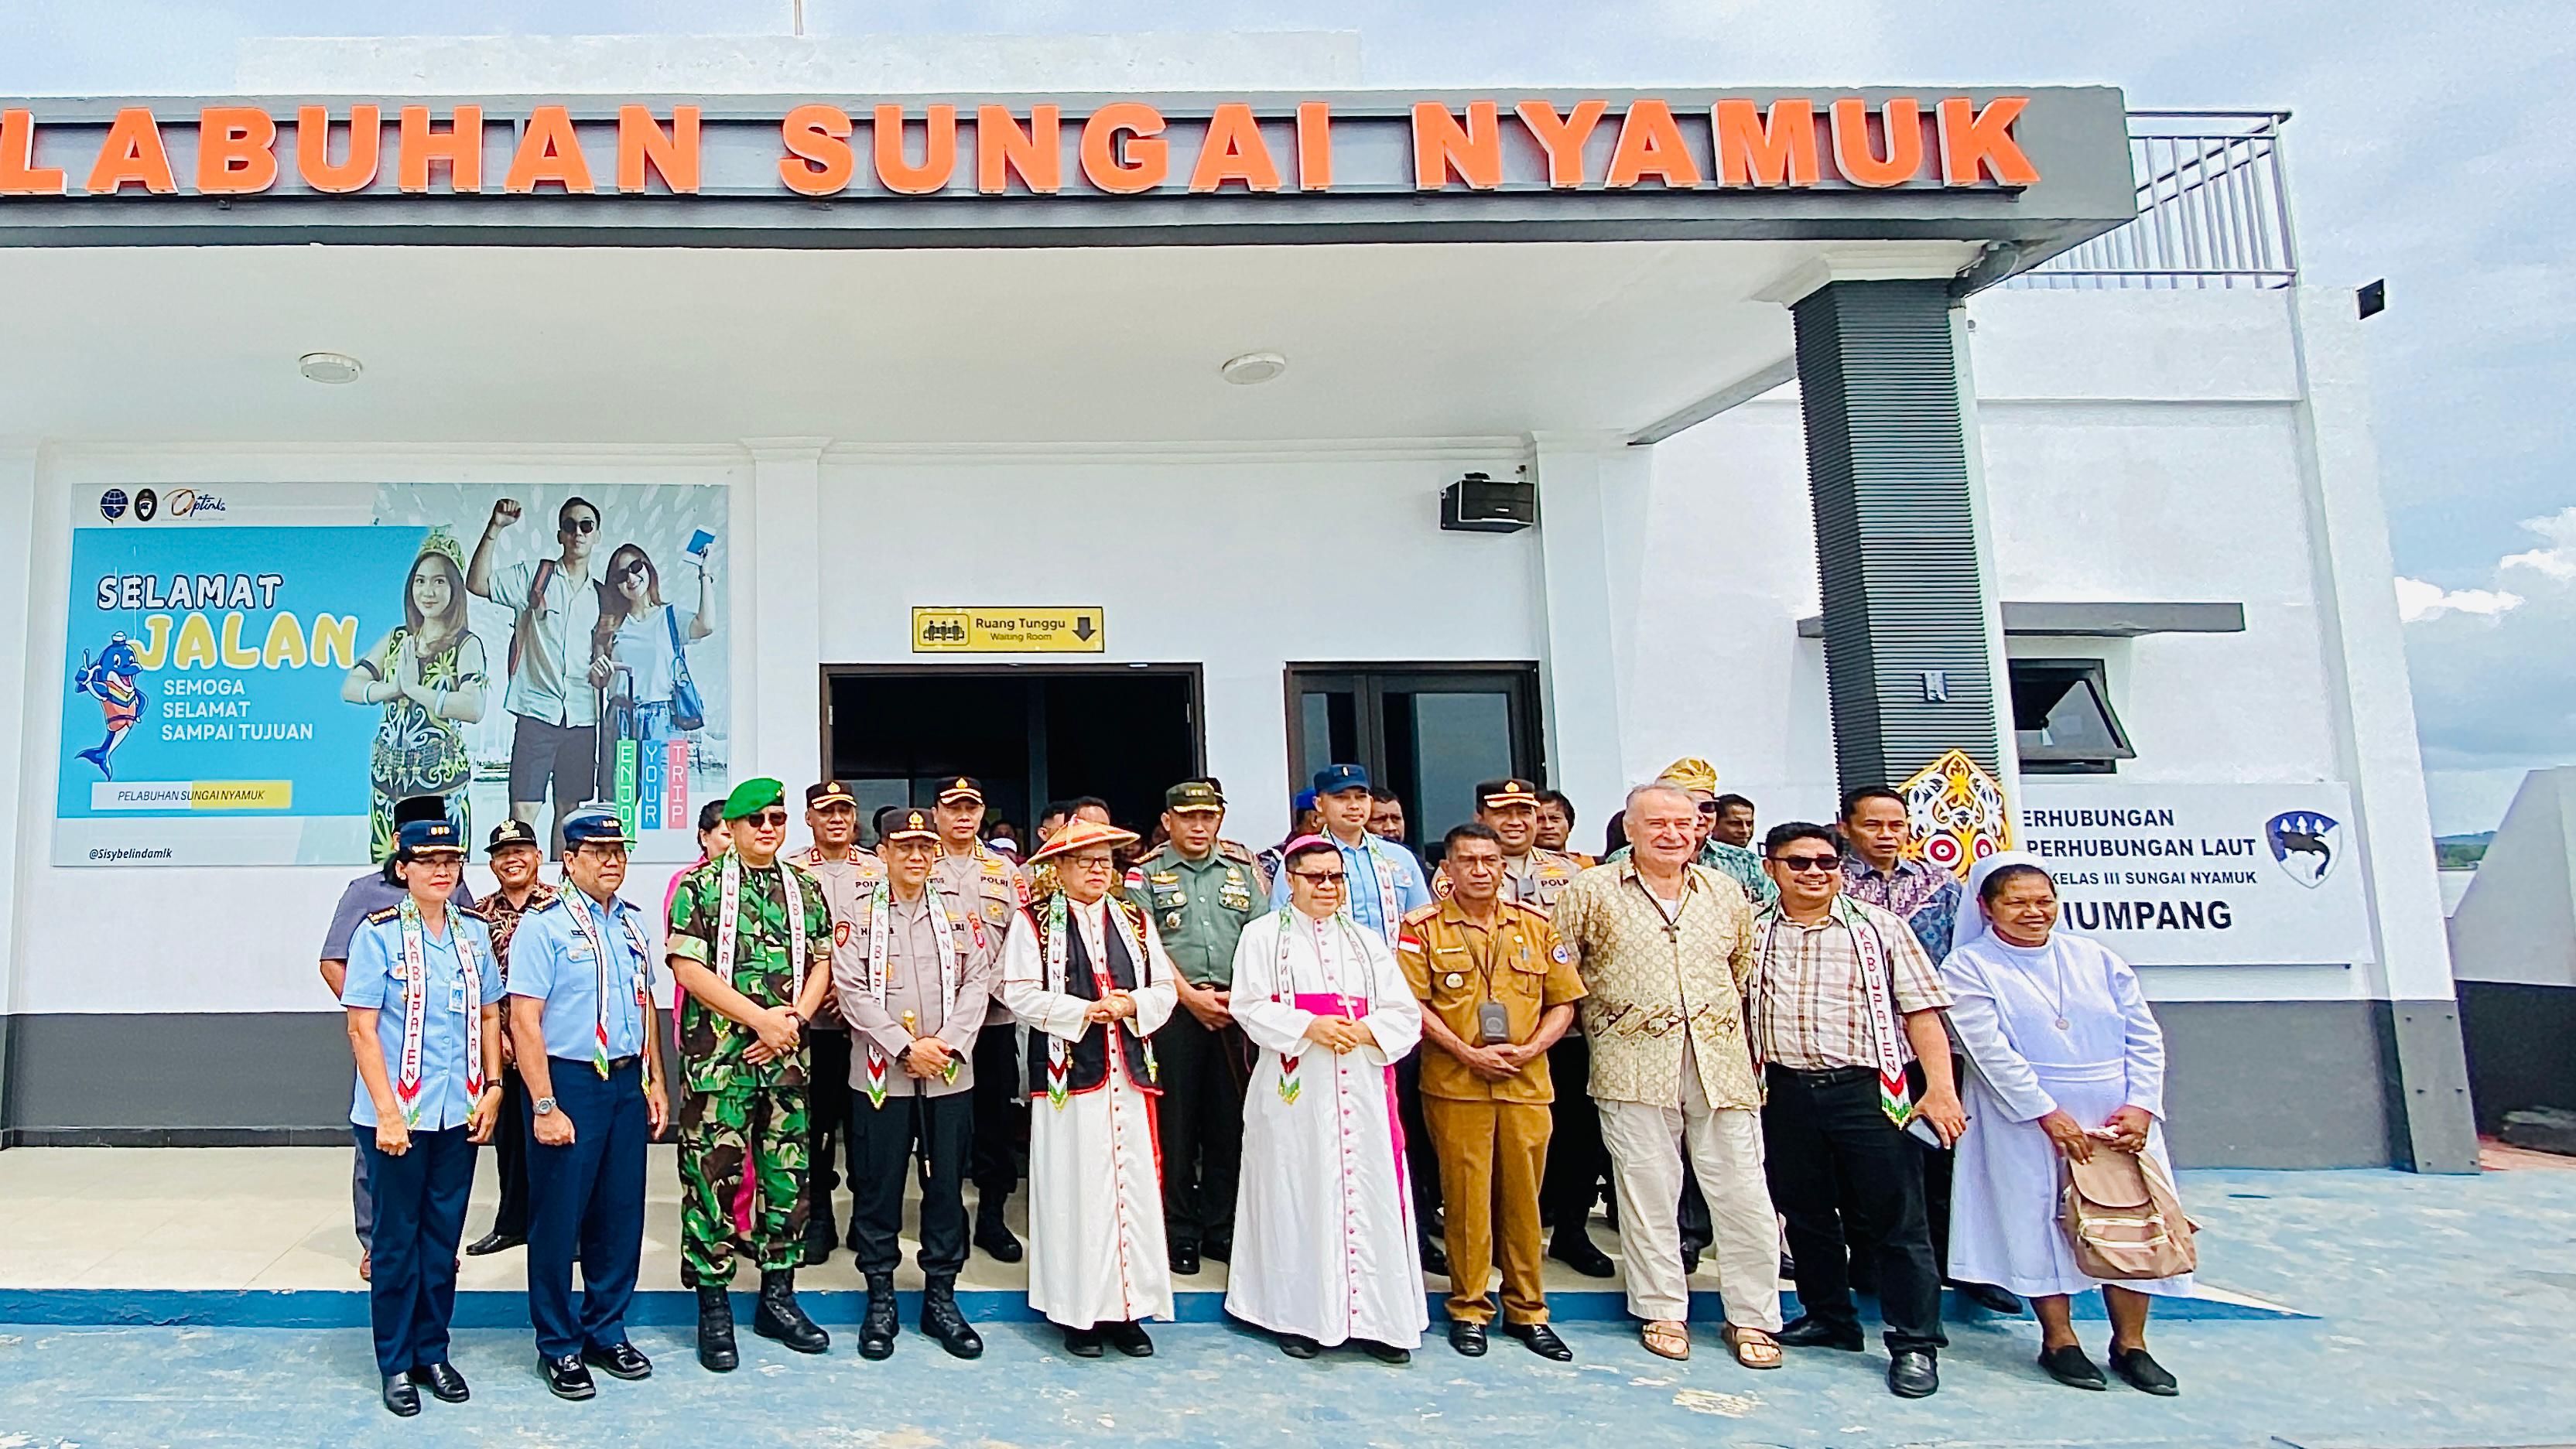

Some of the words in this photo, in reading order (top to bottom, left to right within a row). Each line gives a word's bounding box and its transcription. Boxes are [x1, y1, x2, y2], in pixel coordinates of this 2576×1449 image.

[778, 101, 1331, 196] SUNGAI
[1415, 97, 2041, 192] NYAMUK
[97, 573, 283, 610] SELAMAT
[130, 611, 359, 670] JALAN
[976, 618, 1014, 631] Ruang
[1019, 618, 1066, 631] Tunggu
[162, 701, 251, 718] SELAMAT
[163, 678, 245, 695] SEMOGA
[162, 723, 233, 740] SAMPAI
[238, 723, 313, 740] TUJUAN
[118, 791, 179, 801] PELABUHAN
[180, 791, 218, 801] SUNGAI
[221, 790, 265, 800] NYAMUK
[620, 745, 633, 838] ENJOY
[645, 745, 658, 823] YOUR
[672, 745, 684, 823] TRIP
[2027, 839, 2194, 856] PERHUBUNGAN
[2201, 839, 2256, 856] LAUT
[980, 877, 1007, 887] POLRI
[2104, 873, 2119, 884] III
[2126, 872, 2185, 883] SUNGAI
[2191, 871, 2257, 883] NYAMUK
[720, 872, 734, 980] NUNUKAN
[406, 936, 421, 1080] KABUPATEN
[460, 944, 477, 1069] NUNUKAN
[1858, 928, 1897, 1072] KABUPATEN
